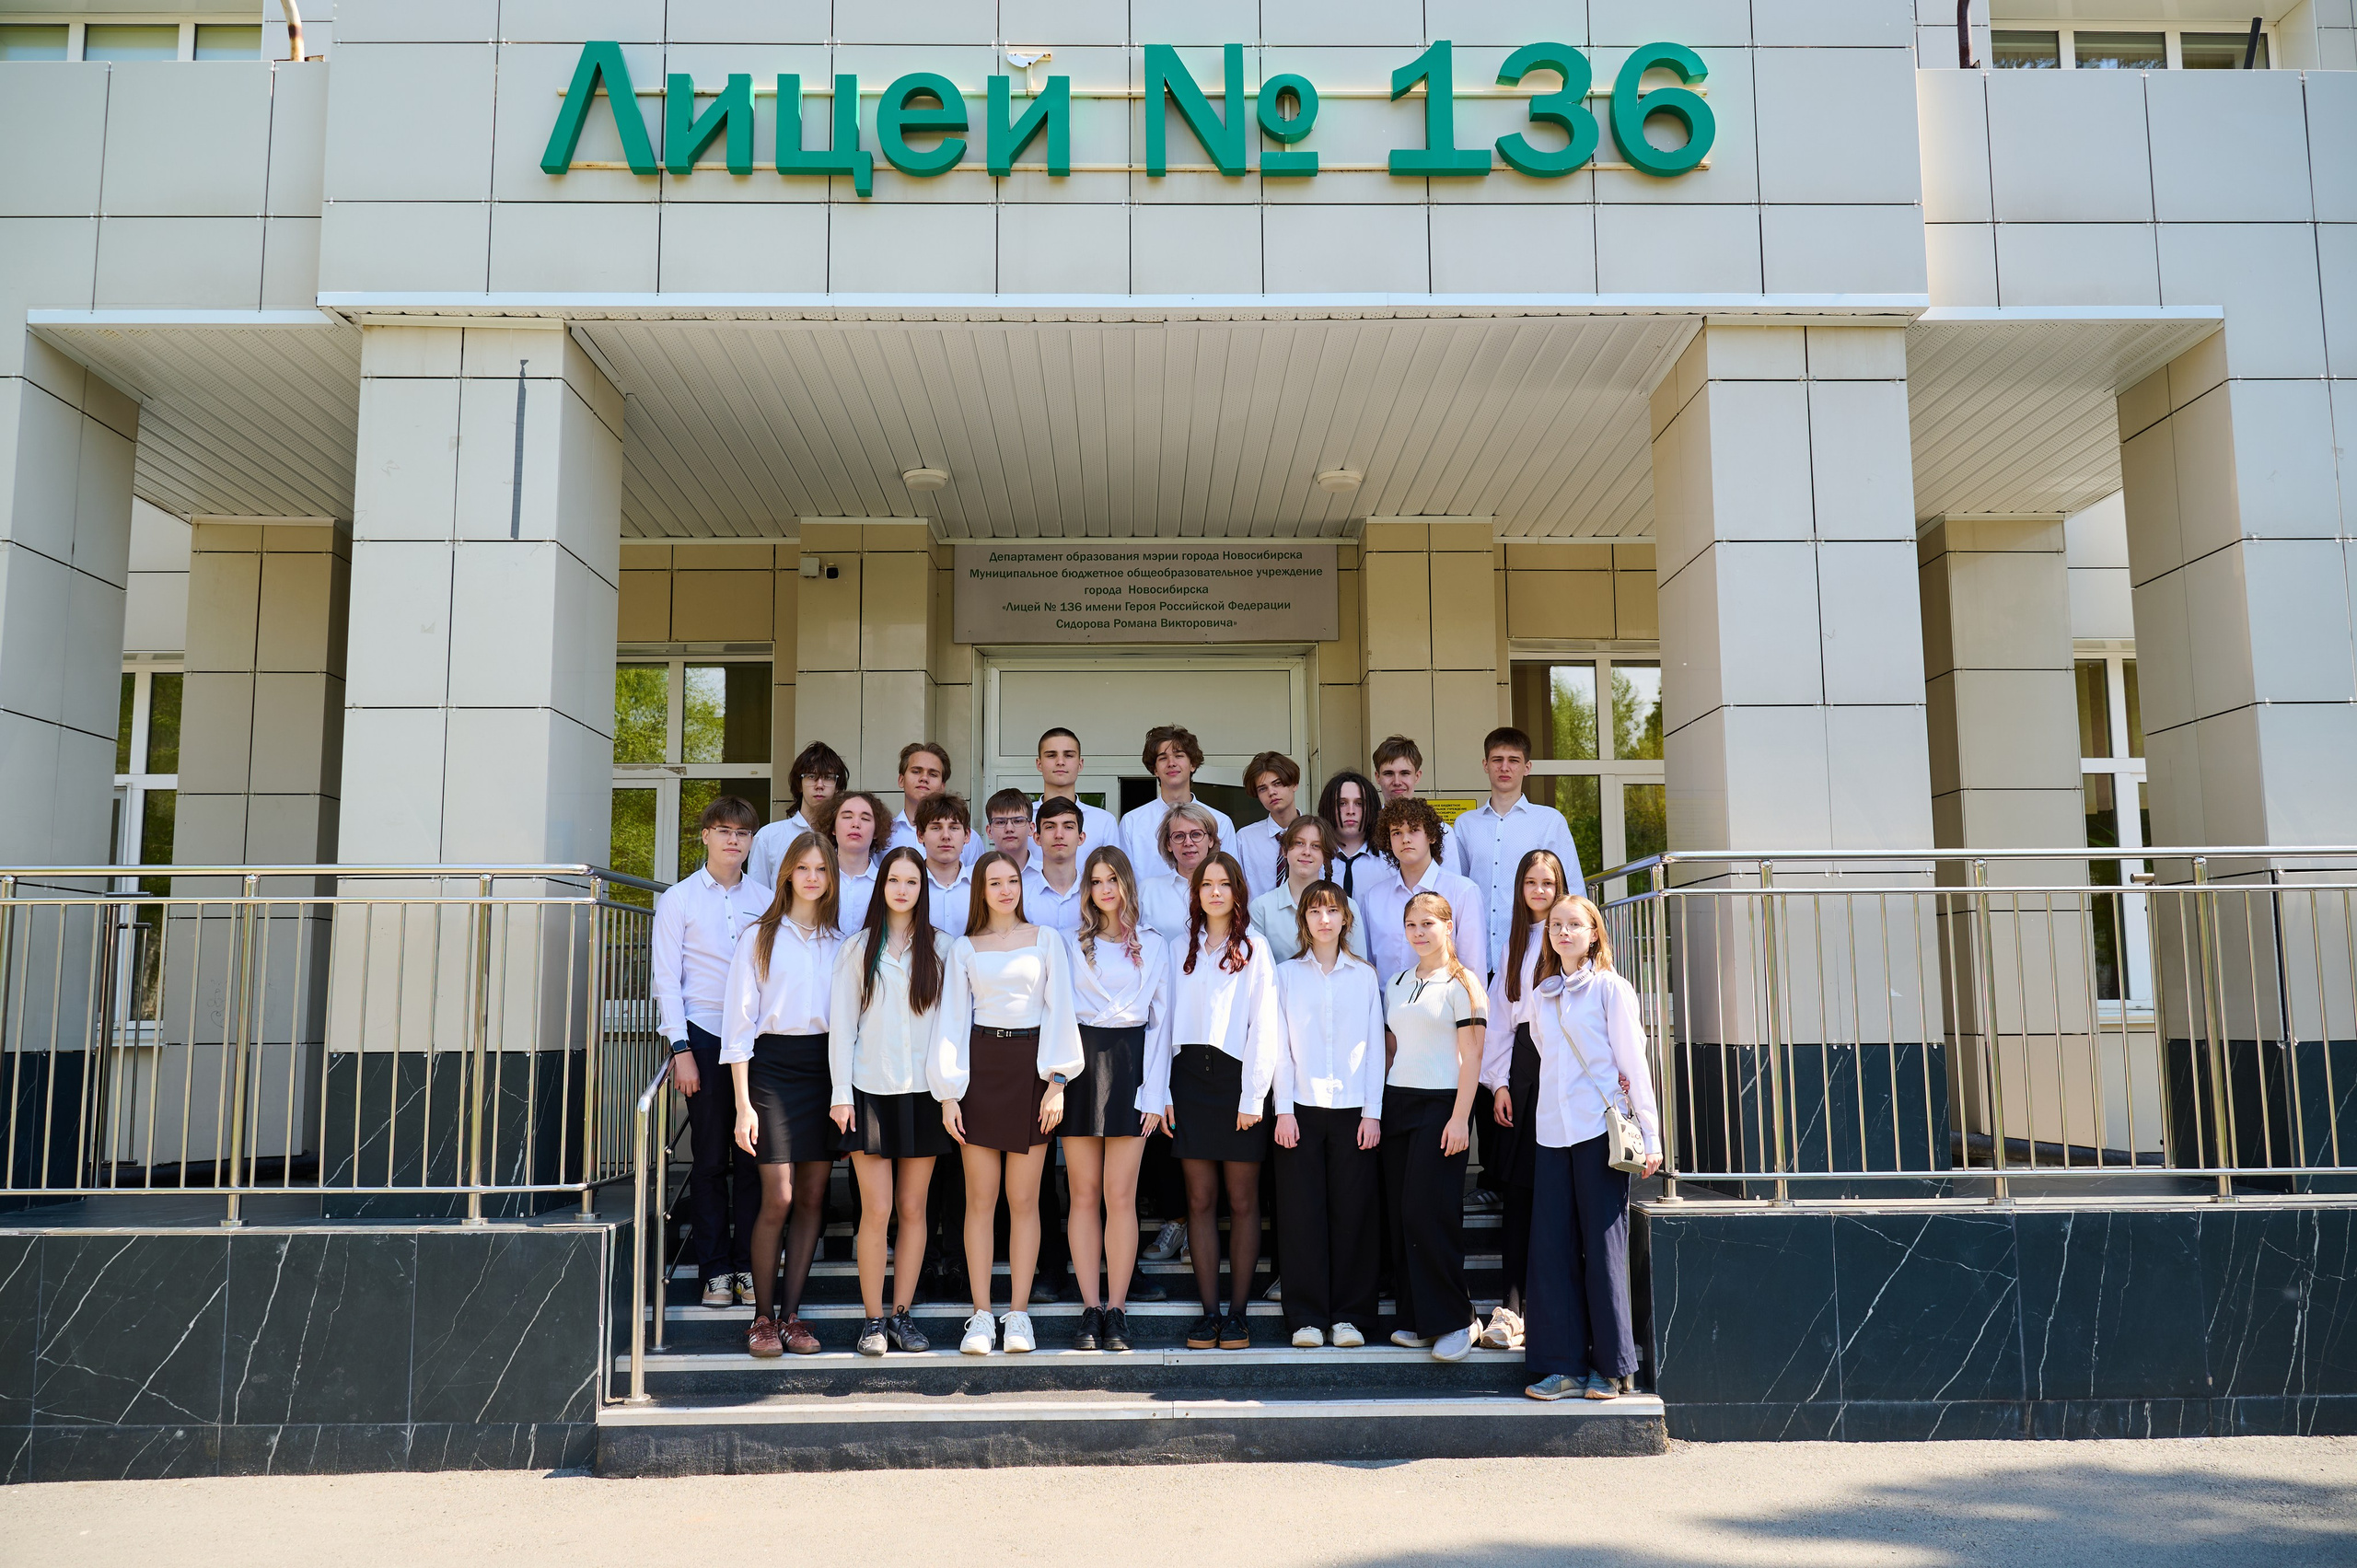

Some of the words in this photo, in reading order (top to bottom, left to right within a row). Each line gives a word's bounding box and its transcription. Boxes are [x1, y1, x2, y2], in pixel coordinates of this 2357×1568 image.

[1144, 43, 1318, 178] №
[1388, 41, 1715, 178] 136
[988, 552, 1064, 563] Департамент
[1065, 552, 1140, 563] образования
[1143, 553, 1178, 562] мэрии
[1181, 553, 1220, 562] города
[1223, 550, 1303, 561] Новосибирска
[970, 569, 1059, 580] Муниципальное
[1061, 568, 1124, 579] бюджетное
[1126, 567, 1254, 579] общеобразовательное
[1256, 569, 1323, 578] учреждение
[1084, 587, 1122, 597] города
[1128, 585, 1209, 596] Новосибирска
[1044, 602, 1057, 611] №
[1060, 602, 1083, 611] 136
[1124, 602, 1156, 612] Героя
[1159, 601, 1225, 610] Российской
[1227, 601, 1291, 611] Федерации
[1055, 620, 1110, 630] Сидорова
[1113, 619, 1157, 628] Романа
